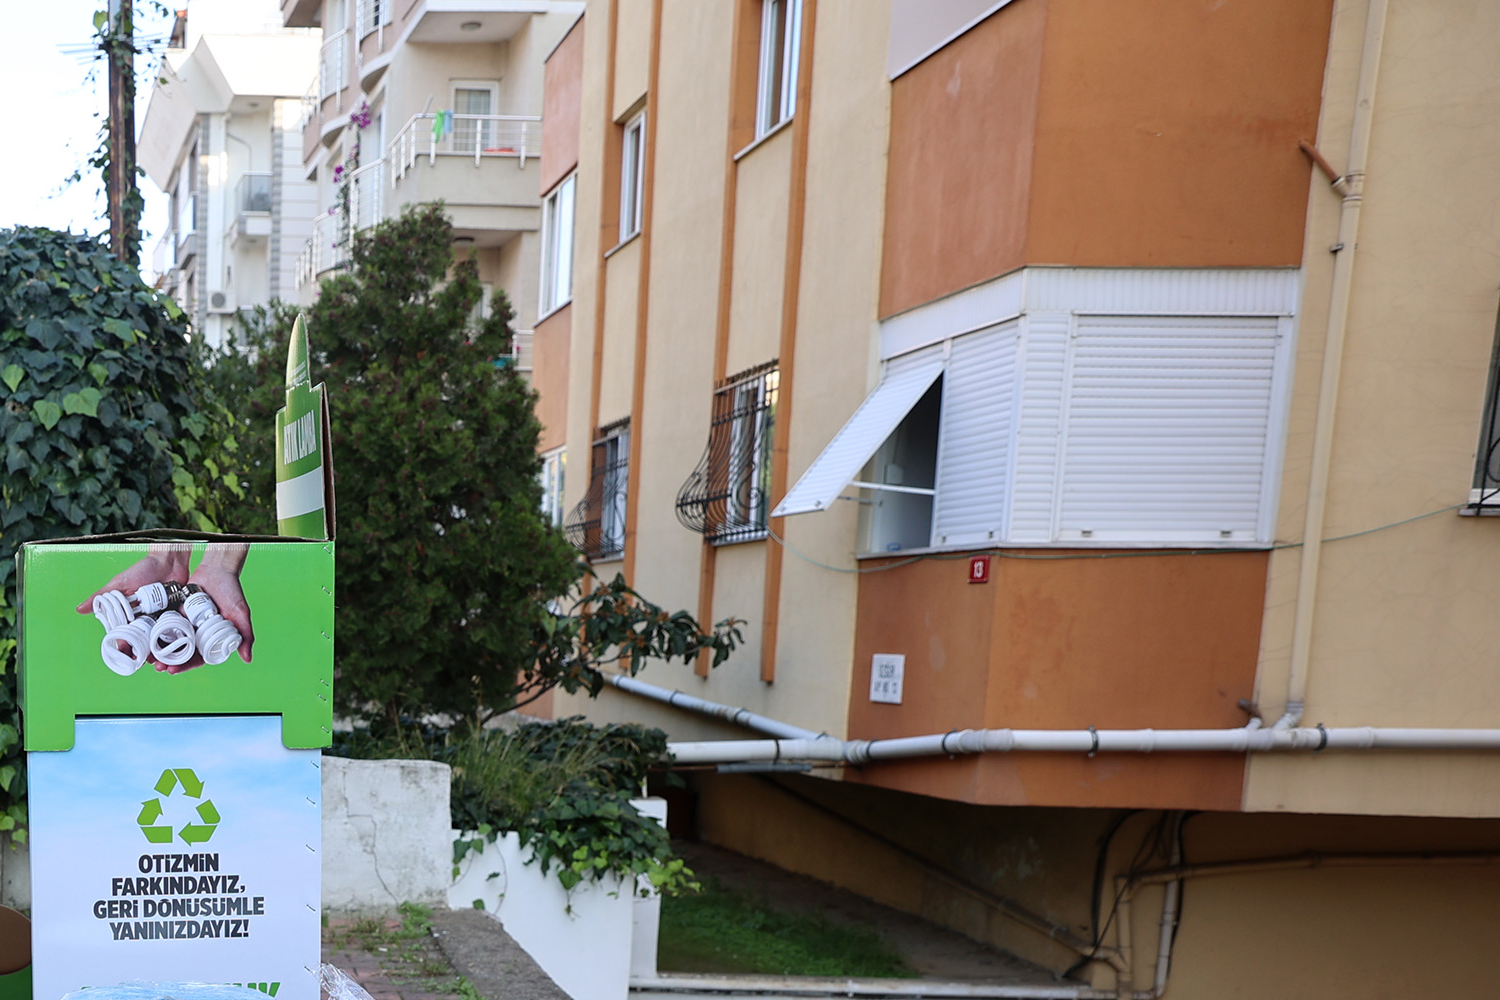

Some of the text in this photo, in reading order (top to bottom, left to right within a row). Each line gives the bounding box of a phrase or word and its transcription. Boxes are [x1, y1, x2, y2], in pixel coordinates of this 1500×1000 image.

[973, 561, 983, 578] 13
[138, 853, 219, 874] OTİZMİN
[111, 875, 246, 896] FARKINDAYIZ,
[93, 897, 265, 919] GERİ DÖNÜŞÜMLE
[109, 919, 250, 940] YANINIZDAYIZ!
